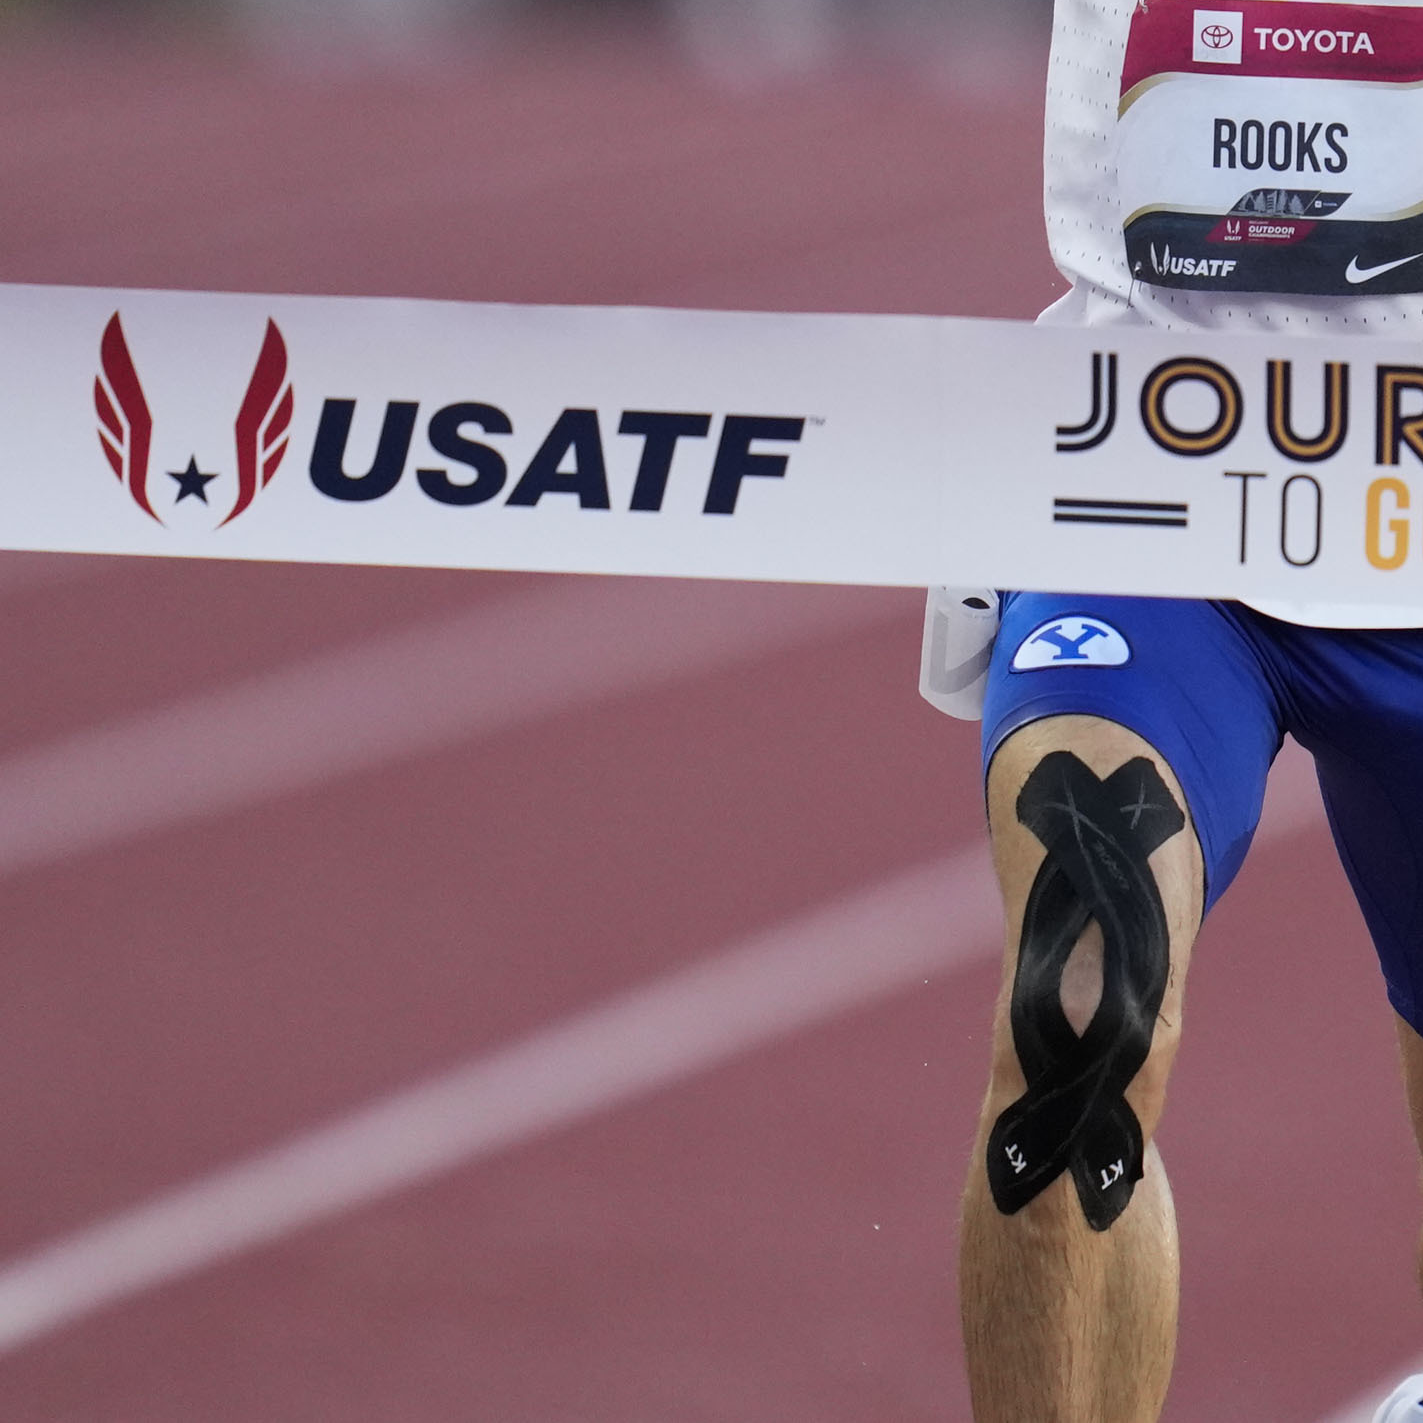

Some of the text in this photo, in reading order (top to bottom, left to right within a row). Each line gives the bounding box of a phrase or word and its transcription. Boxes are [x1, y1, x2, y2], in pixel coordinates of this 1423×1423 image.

[1254, 27, 1375, 55] TOYOTA
[1212, 118, 1350, 174] ROOKS
[1248, 225, 1295, 235] OUTDOOR
[1170, 256, 1237, 277] USATF
[309, 398, 806, 516] USATF
[1224, 471, 1323, 566] TO
[1004, 1143, 1028, 1174] KT
[1100, 1158, 1125, 1191] KT
